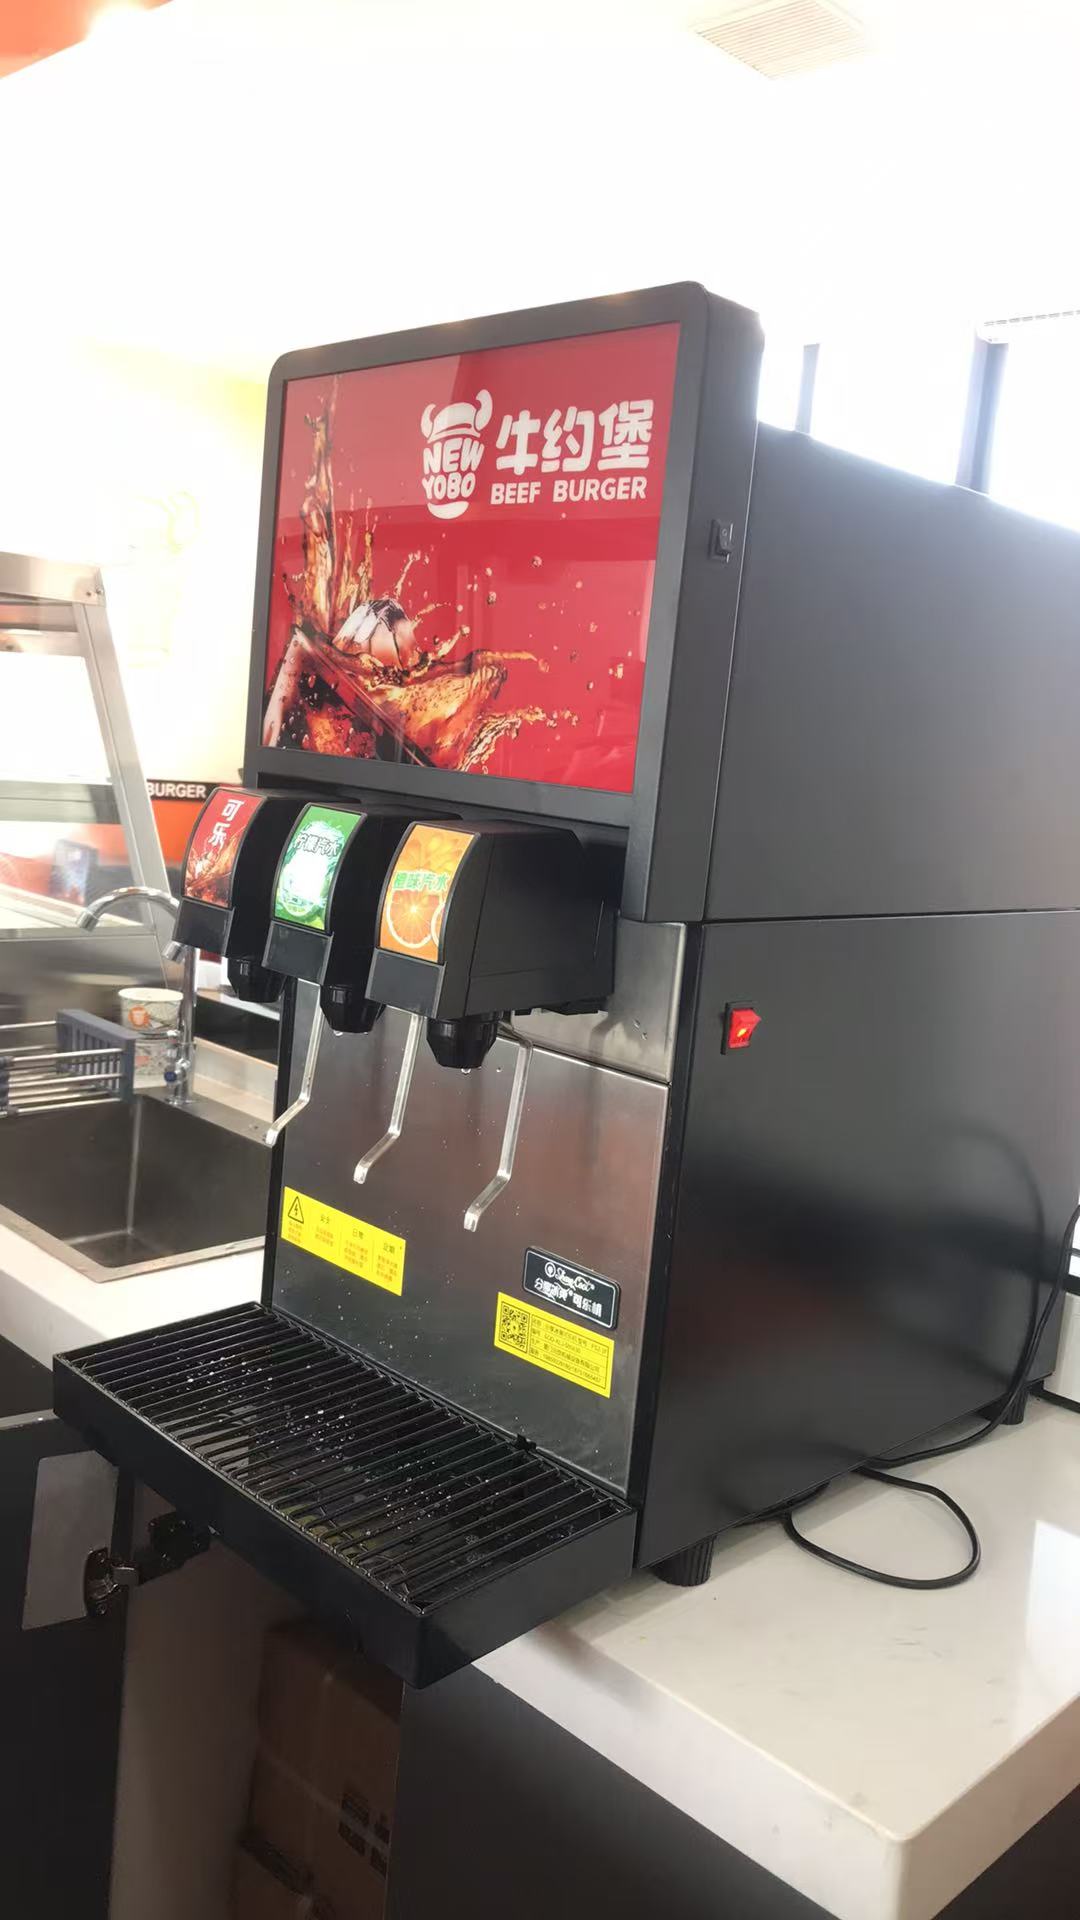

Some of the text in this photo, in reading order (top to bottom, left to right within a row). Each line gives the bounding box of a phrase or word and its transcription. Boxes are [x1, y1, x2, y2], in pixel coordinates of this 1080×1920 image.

[496, 399, 654, 476] 牛约堡
[423, 437, 485, 474] NEW
[421, 472, 476, 500] YOBO
[490, 476, 648, 504] BEEF BURGER
[147, 782, 207, 799] BURGER
[208, 799, 244, 848] 可乐
